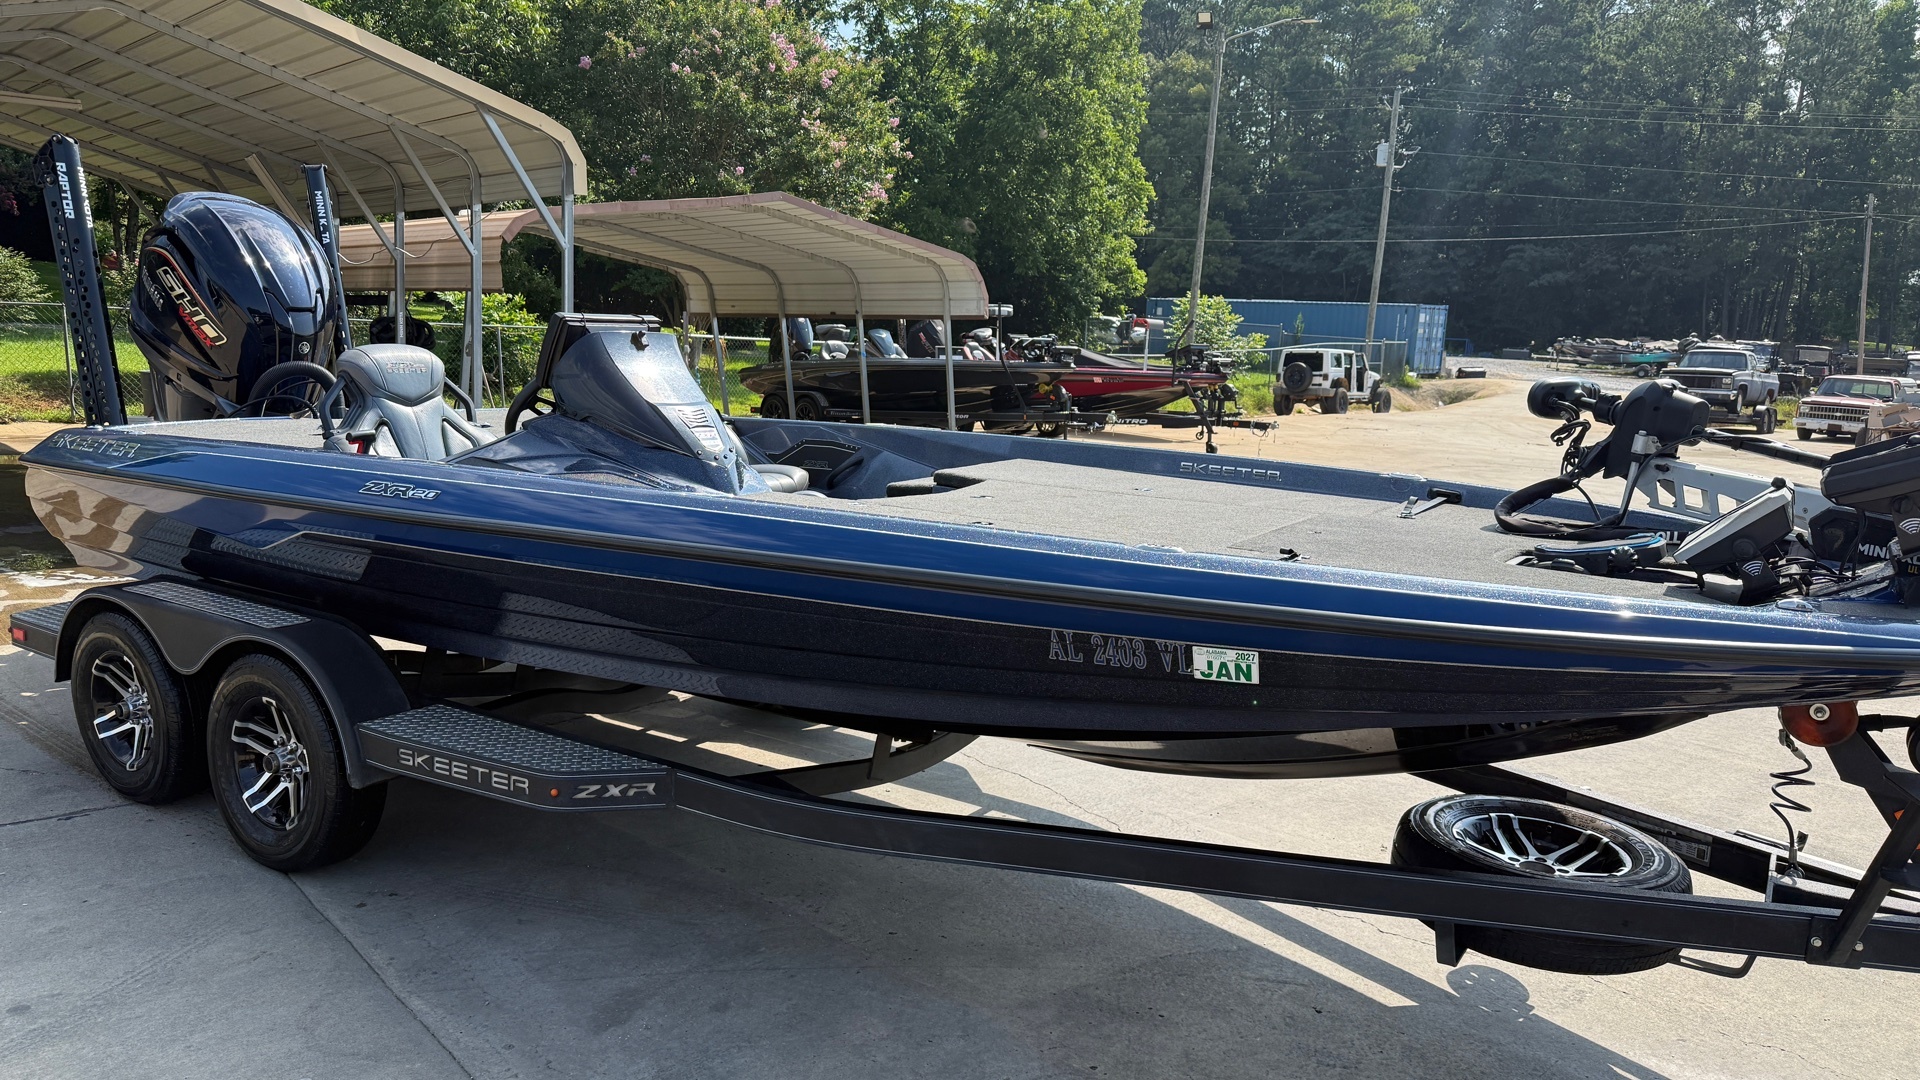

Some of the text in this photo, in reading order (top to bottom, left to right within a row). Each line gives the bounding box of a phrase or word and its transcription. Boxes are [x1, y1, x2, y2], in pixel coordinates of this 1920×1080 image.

[56, 162, 75, 219] RAPTOR
[77, 166, 94, 228] MINN KOTA
[314, 190, 331, 245] MINN KTA
[156, 266, 228, 346] SHO
[48, 433, 141, 458] SKEETER
[1179, 461, 1281, 482] SKEETER
[1049, 629, 1083, 662] AL
[1091, 634, 1147, 669] 2403
[1199, 660, 1253, 682] JAN
[1235, 652, 1256, 662] 2027
[398, 748, 657, 799] SKEETER ZXR
